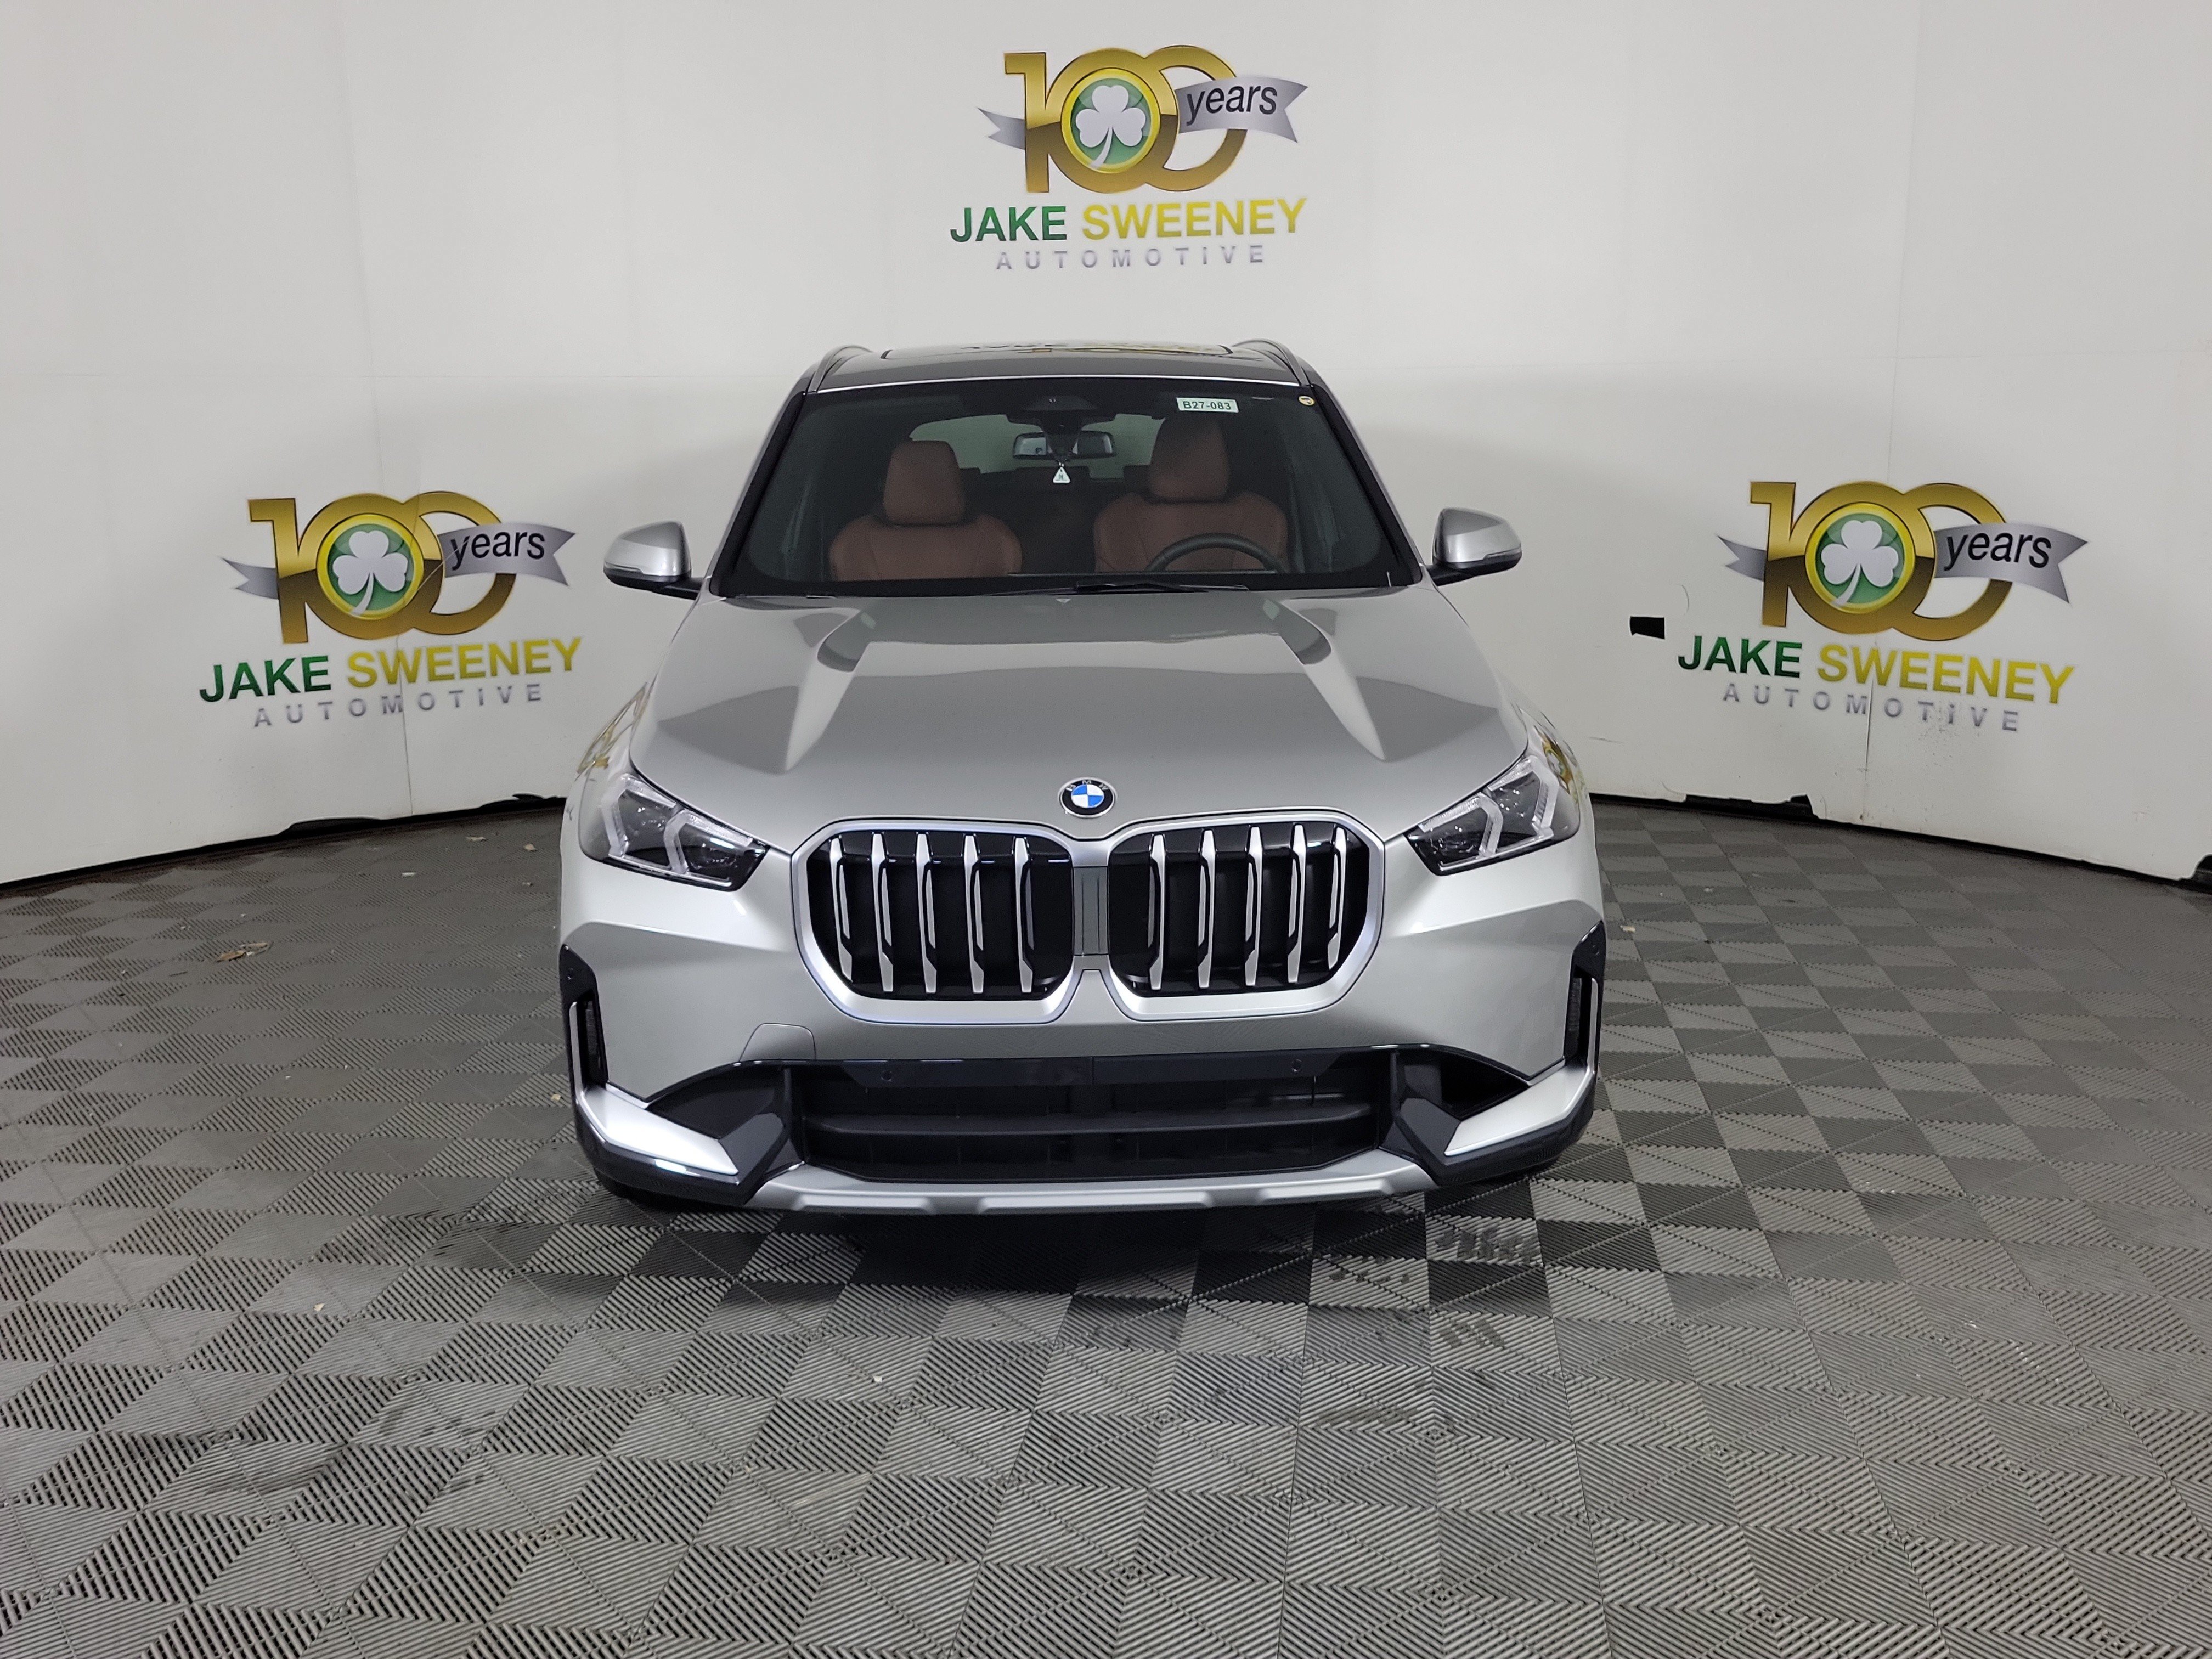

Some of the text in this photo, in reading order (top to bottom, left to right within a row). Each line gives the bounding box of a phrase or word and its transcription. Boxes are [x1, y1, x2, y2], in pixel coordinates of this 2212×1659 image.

[1003, 45, 1248, 194] 100
[1186, 86, 1278, 127] years
[950, 198, 1308, 242] JAKE SWEENEY
[996, 245, 1263, 270] AUTOMOTIVE
[1182, 400, 1232, 410] B27-083
[247, 490, 517, 644] 100
[450, 531, 546, 571] years
[1750, 481, 2013, 642] 100
[1944, 532, 2052, 572] years
[199, 637, 583, 703] JAKE SWEENEY
[1678, 635, 2075, 705] JAKE SWEENEY
[253, 684, 542, 728] AUTOMOTIVE
[1723, 683, 2019, 732] AUTOMOTIVE
